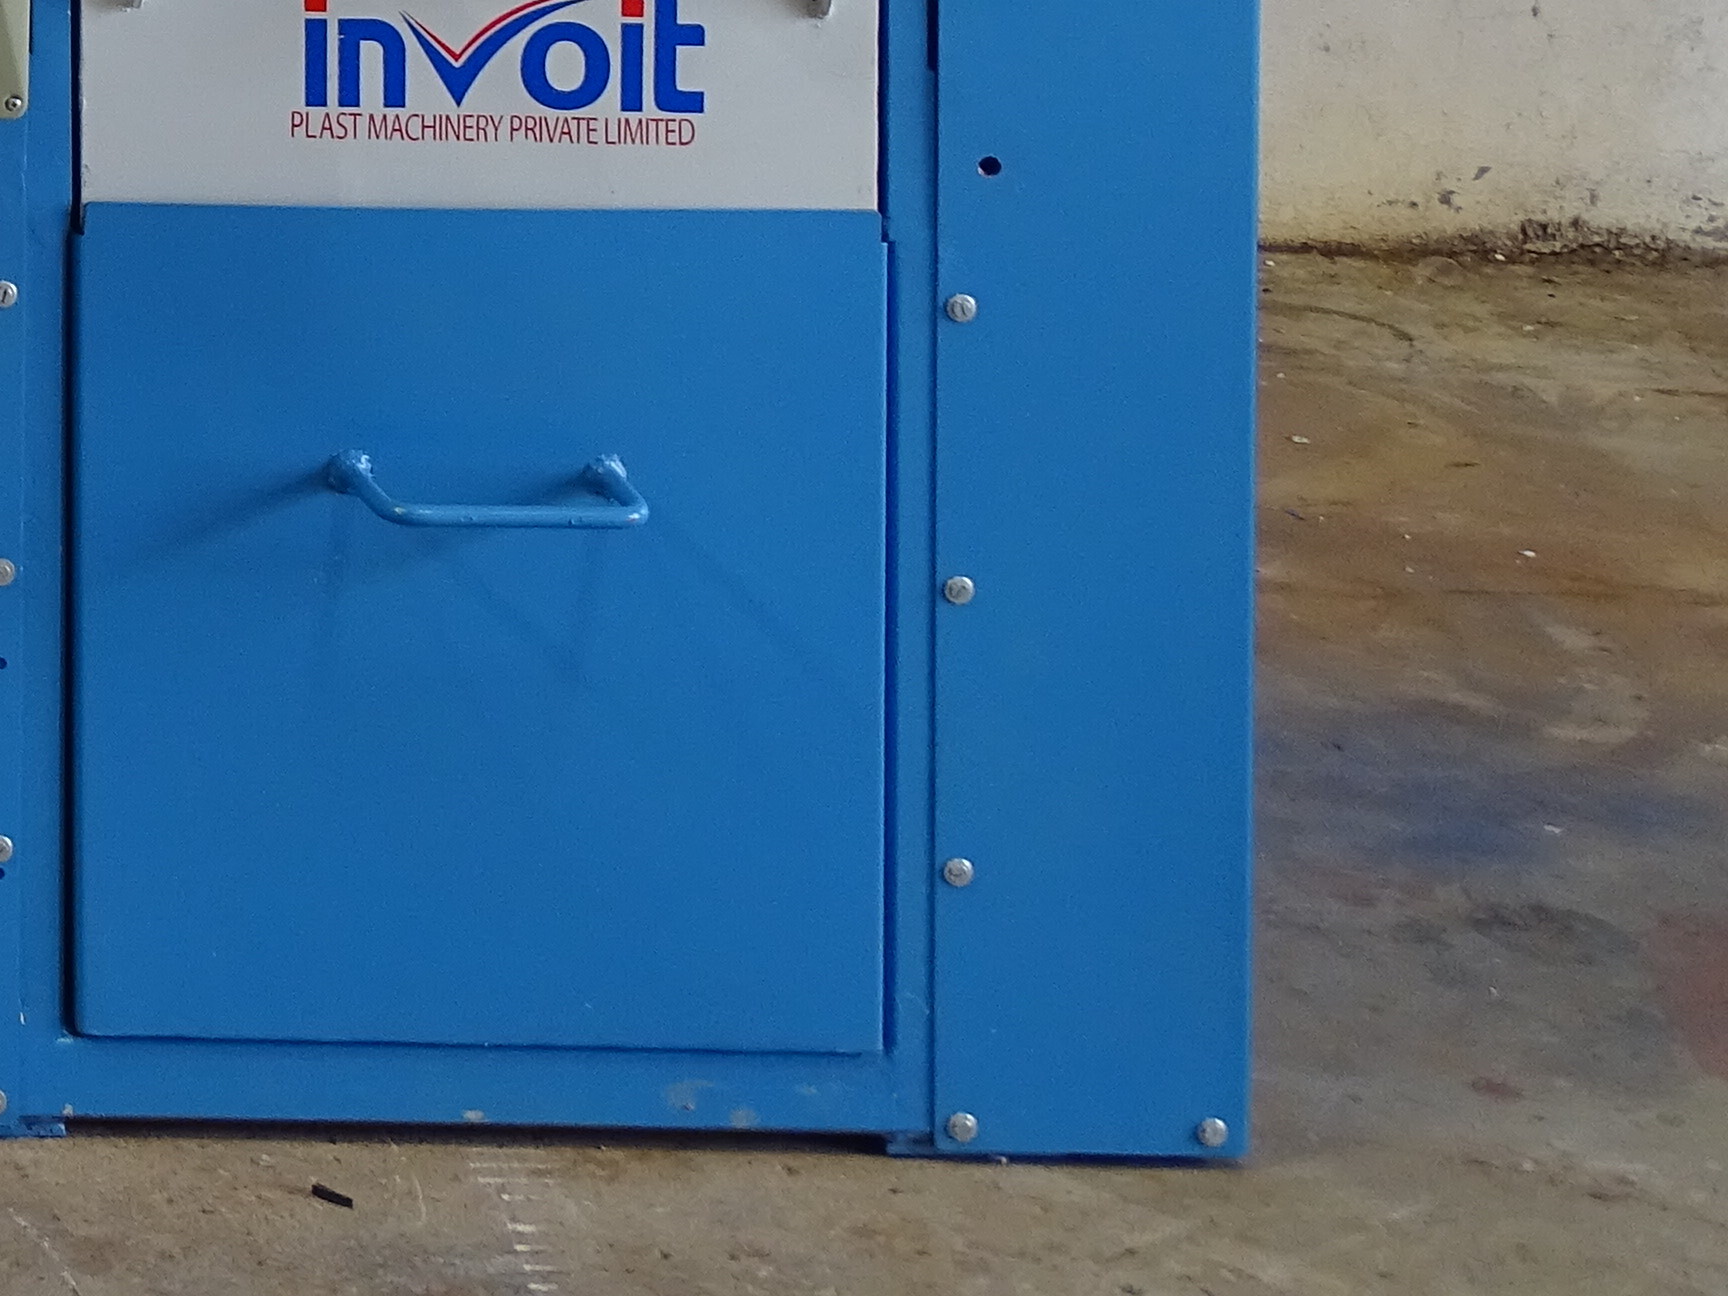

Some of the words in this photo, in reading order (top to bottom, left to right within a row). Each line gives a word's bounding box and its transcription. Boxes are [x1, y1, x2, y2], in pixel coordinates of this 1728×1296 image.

[291, 111, 362, 140] PLAST
[368, 113, 504, 143] MACHINERY
[510, 116, 598, 145] PRIVATE
[604, 117, 695, 146] LIMITED
